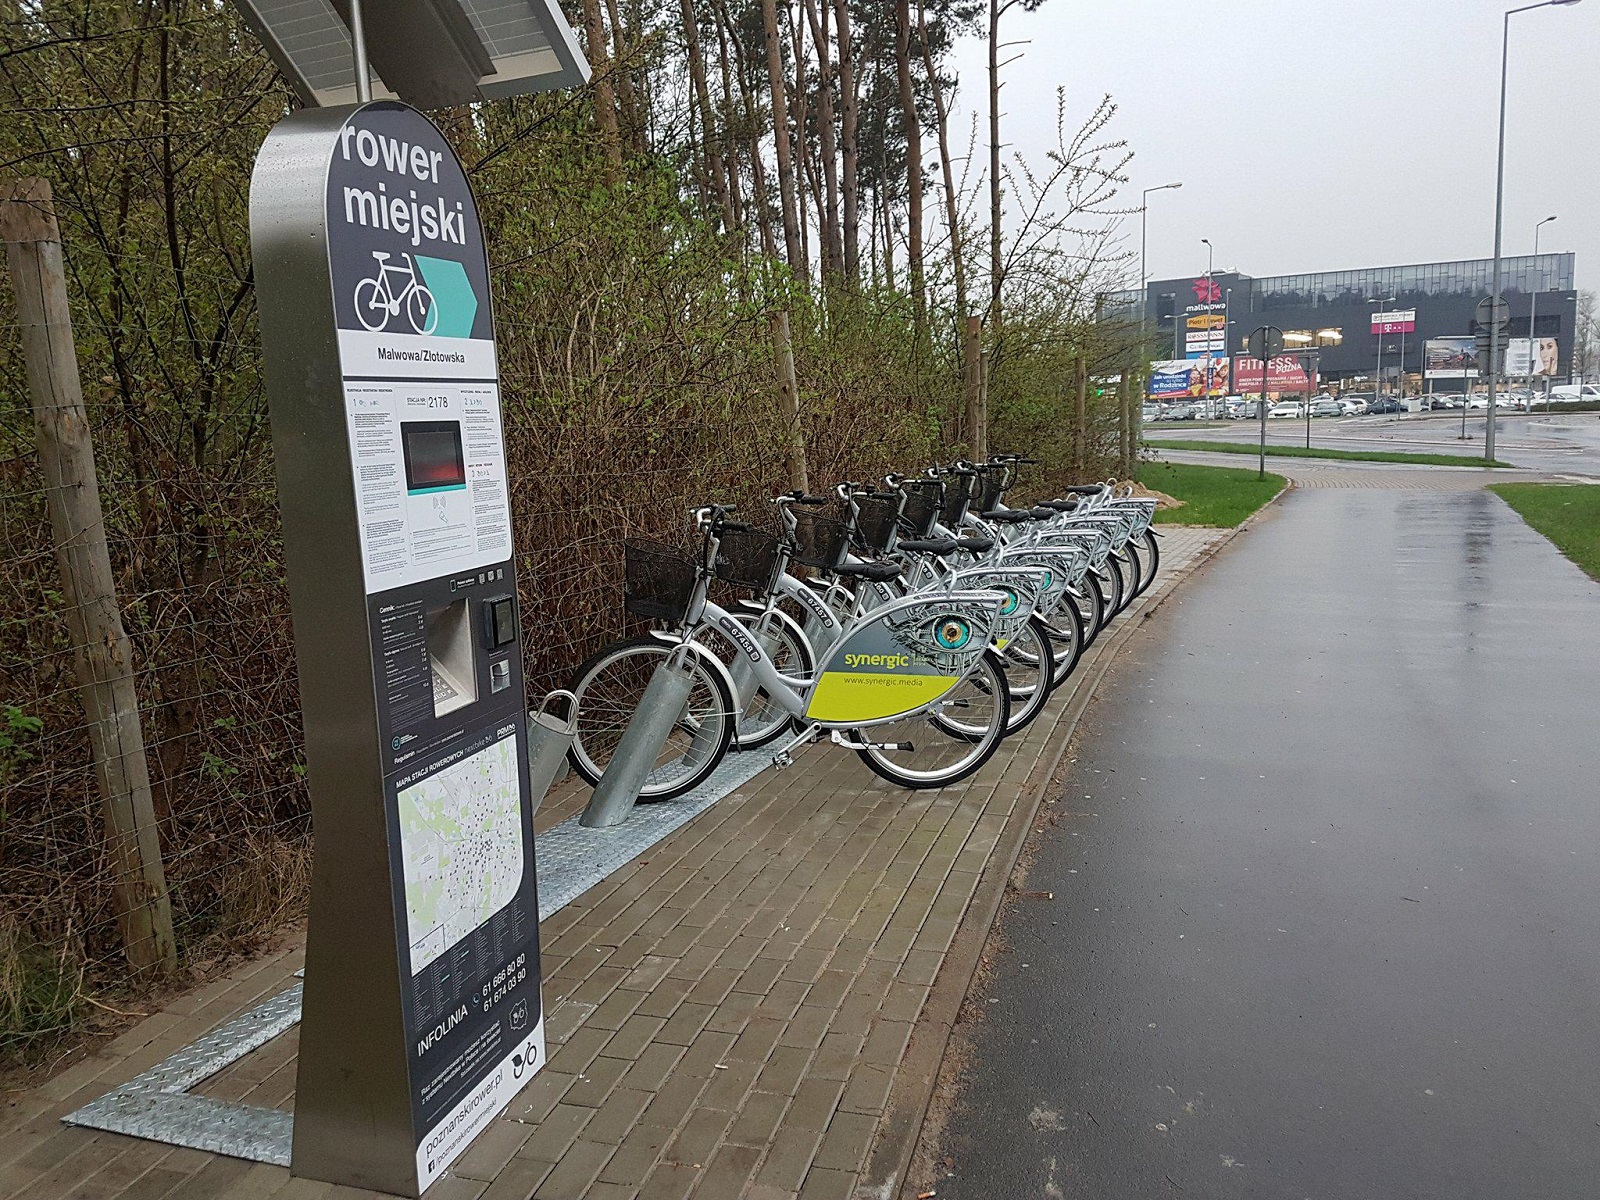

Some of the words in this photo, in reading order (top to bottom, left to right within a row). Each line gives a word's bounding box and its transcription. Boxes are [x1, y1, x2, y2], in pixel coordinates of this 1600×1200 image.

[340, 125, 443, 184] rower
[343, 183, 466, 247] miejski
[1186, 302, 1226, 312] mallwowa
[377, 347, 465, 363] Malwowa/Złotowska
[1239, 357, 1293, 370] FITNESS
[1276, 363, 1302, 375] POZNA
[428, 396, 449, 408] 2178
[731, 628, 754, 653] 67458
[844, 652, 909, 670] synergic
[843, 677, 923, 687] www.synergic.media
[396, 775, 412, 788] MAPA
[411, 766, 429, 781] STACJI
[429, 749, 464, 772] ROWEROWYCH
[482, 984, 491, 997] 61
[492, 971, 506, 988] 666
[507, 963, 516, 976] 80
[516, 953, 525, 967] 80
[483, 999, 493, 1012] 61
[493, 987, 507, 1003] 674
[507, 977, 517, 991] 03
[517, 968, 526, 982] 90
[417, 1004, 469, 1057] INFOLINIA
[426, 1069, 504, 1159] poznanskirower.pl
